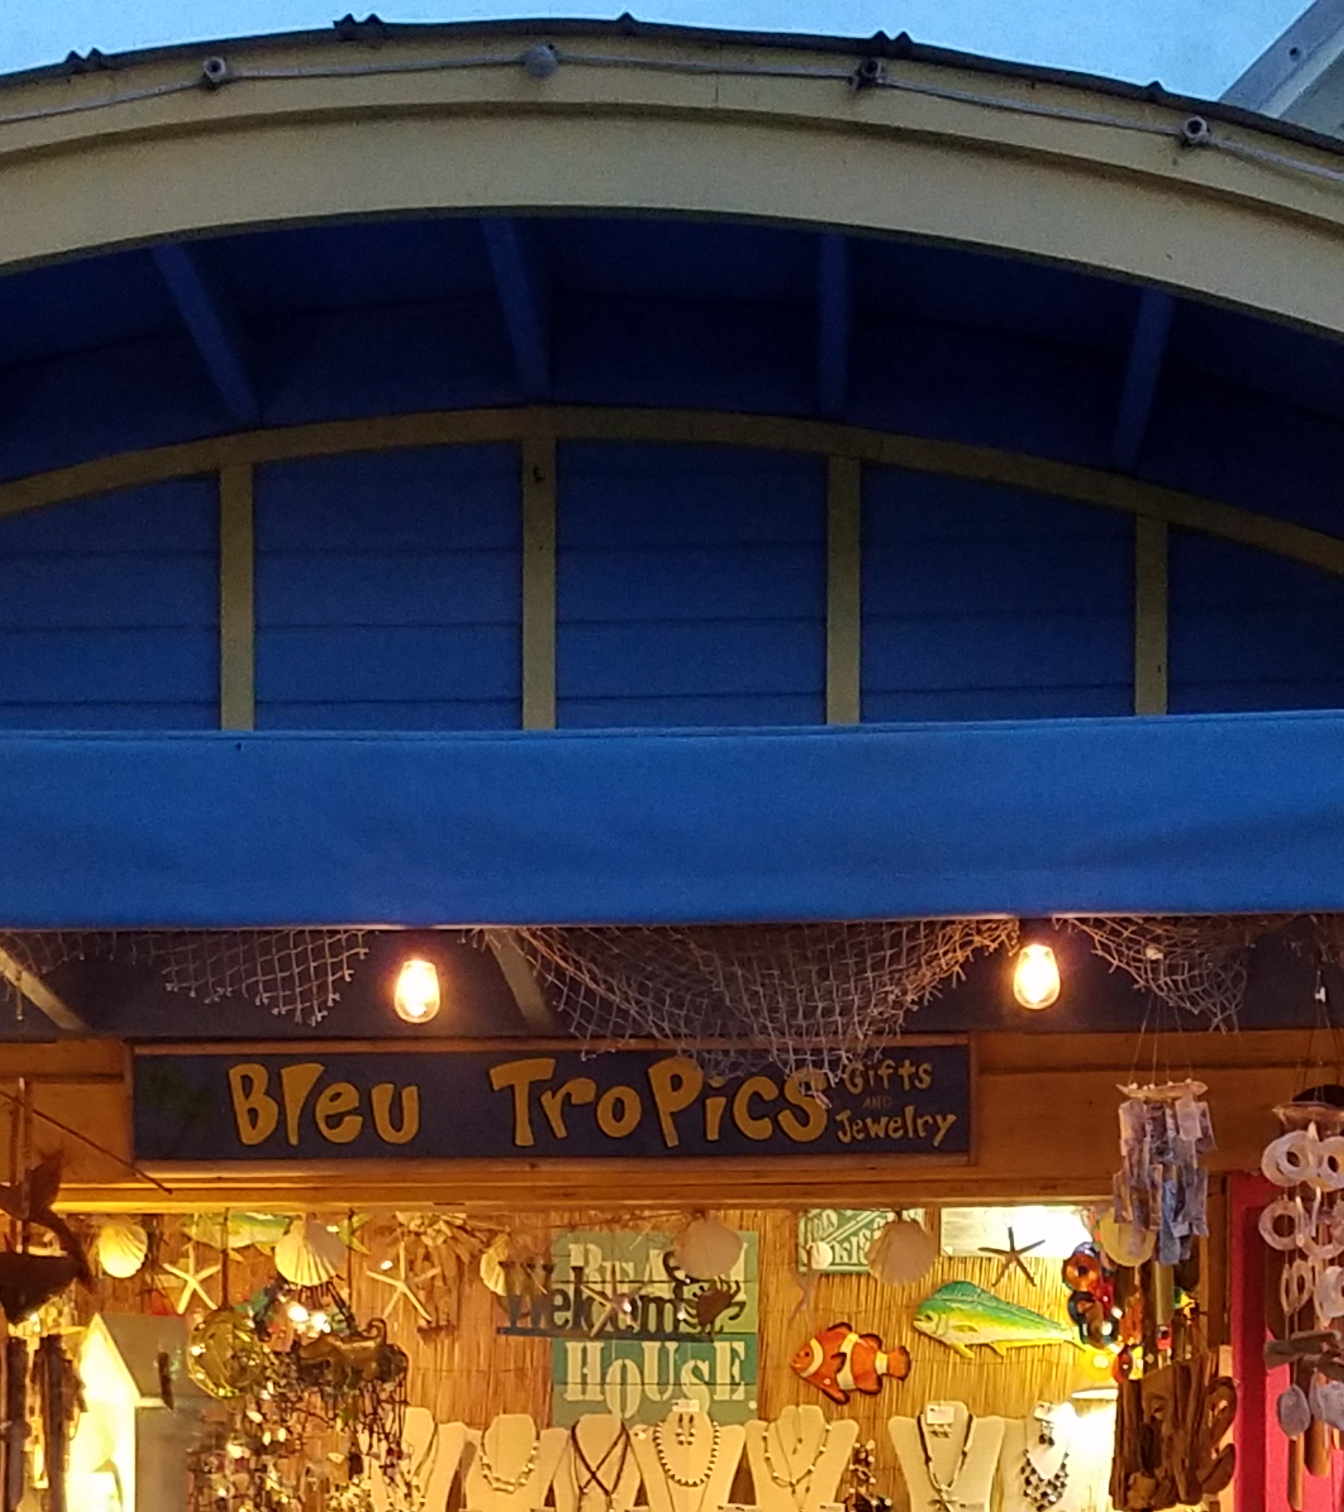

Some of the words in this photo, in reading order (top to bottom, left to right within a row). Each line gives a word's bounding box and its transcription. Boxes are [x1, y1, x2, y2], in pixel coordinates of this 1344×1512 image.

[227, 1062, 420, 1146] Bleu
[842, 1058, 933, 1095] Gifts
[835, 1108, 957, 1148] Jewelry
[563, 1340, 746, 1418] HOUSE
